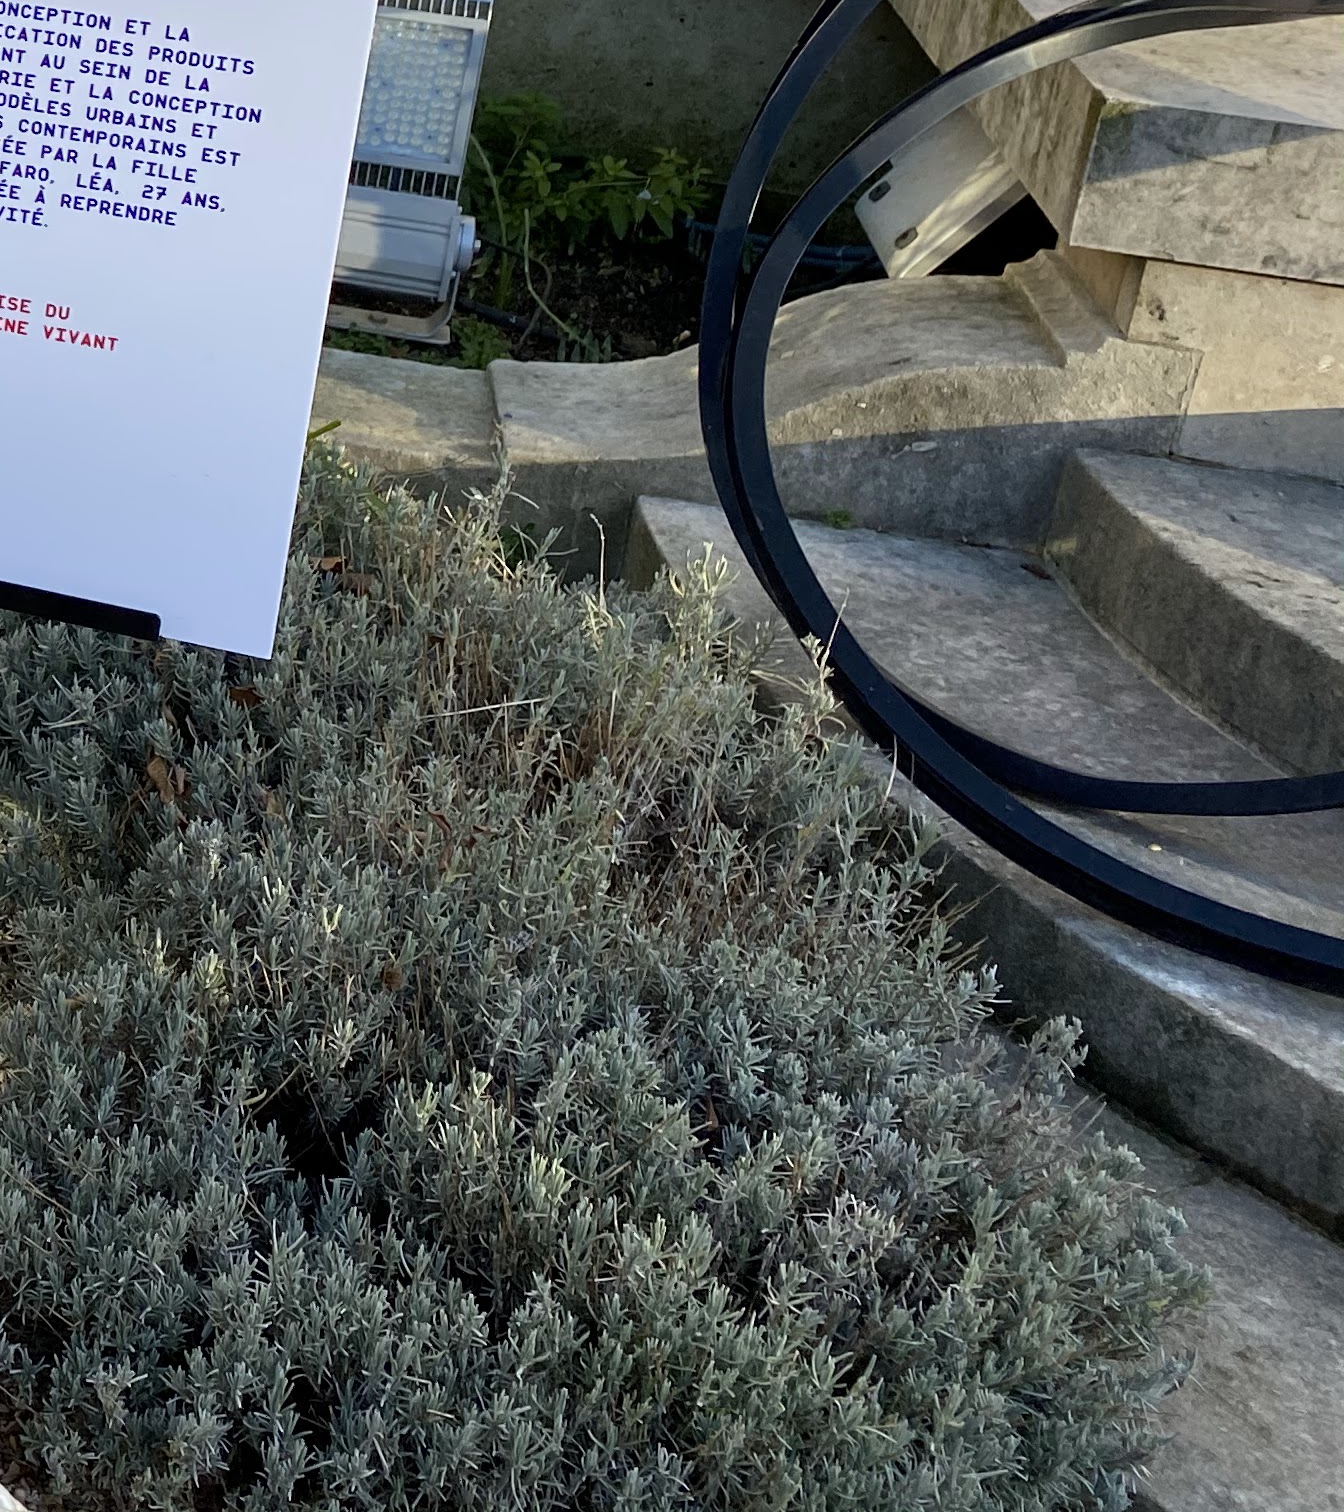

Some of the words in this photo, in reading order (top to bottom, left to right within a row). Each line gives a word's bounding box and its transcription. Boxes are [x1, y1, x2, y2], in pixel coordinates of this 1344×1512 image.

[123, 17, 152, 36] ET
[163, 23, 190, 43] LA
[38, 52, 66, 70] AU
[77, 57, 132, 81] SEIN
[143, 67, 172, 87] DE
[183, 73, 210, 93] LA
[94, 36, 134, 58] DES
[146, 44, 255, 75] PRODUITS
[48, 76, 76, 95] ET
[87, 82, 114, 101] LA
[127, 88, 263, 124] CONCEPTION
[17, 117, 187, 159] CONTEMPORAINS
[199, 146, 242, 167] EST
[84, 104, 177, 134] URBAINS
[189, 121, 218, 140] ET
[39, 143, 79, 165] PAR
[91, 151, 117, 171] LA
[130, 158, 198, 184] FILLE
[32, 183, 46, 205] À
[58, 192, 178, 227] REPRENDRE
[75, 170, 120, 196] LÉA,
[140, 183, 168, 201] 27
[179, 189, 226, 213] ANS,
[44, 302, 71, 321] DU
[42, 323, 119, 352] VIVANT
